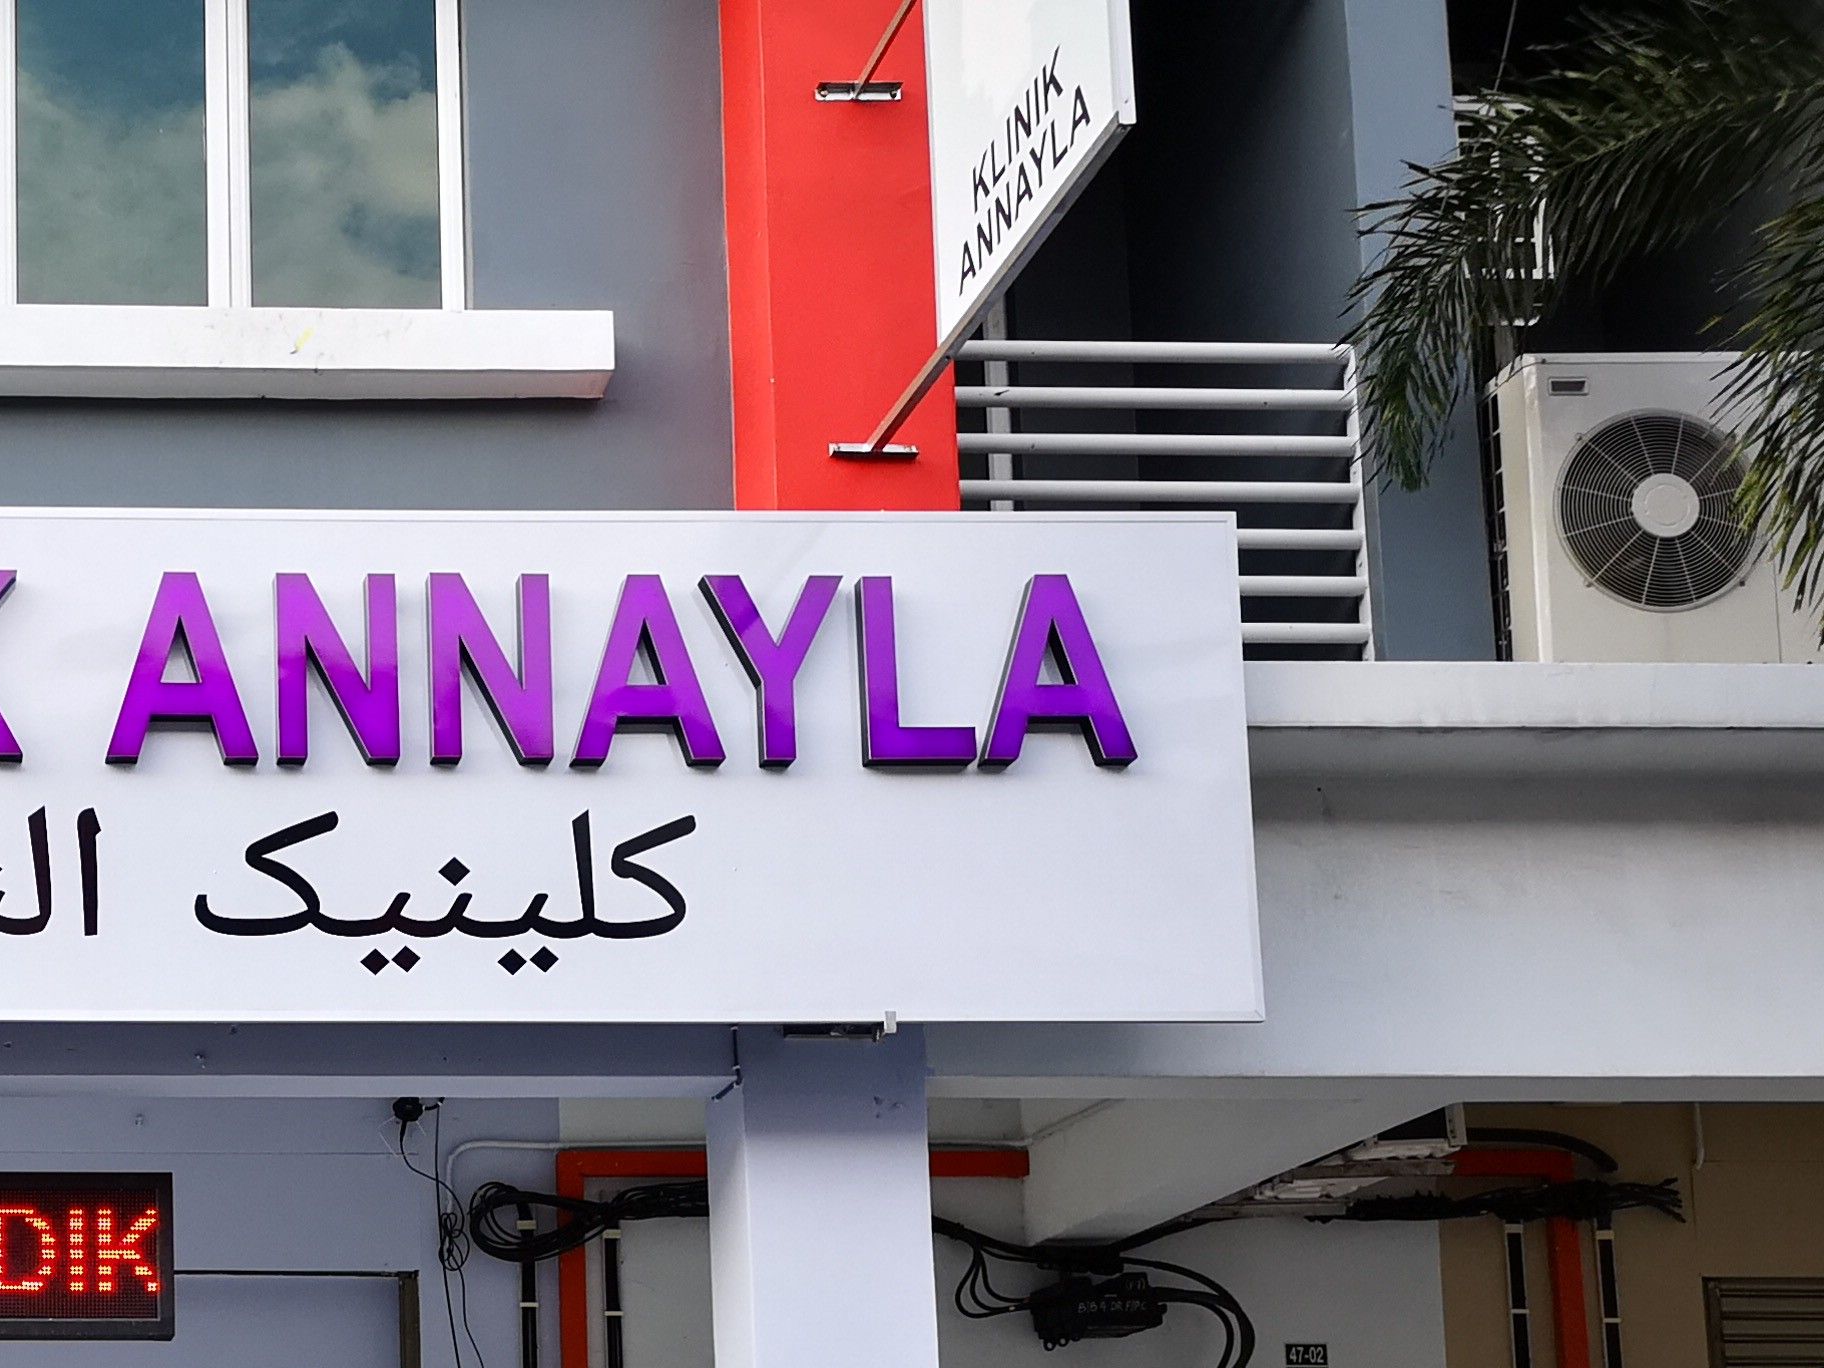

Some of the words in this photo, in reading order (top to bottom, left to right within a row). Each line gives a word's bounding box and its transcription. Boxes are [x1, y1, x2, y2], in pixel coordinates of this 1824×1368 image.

[959, 85, 1090, 296] ANNAYLA
[972, 45, 1063, 214] KLINIK
[104, 571, 1138, 769] ANNAYLA
[1289, 1346, 1325, 1363] 47-02
